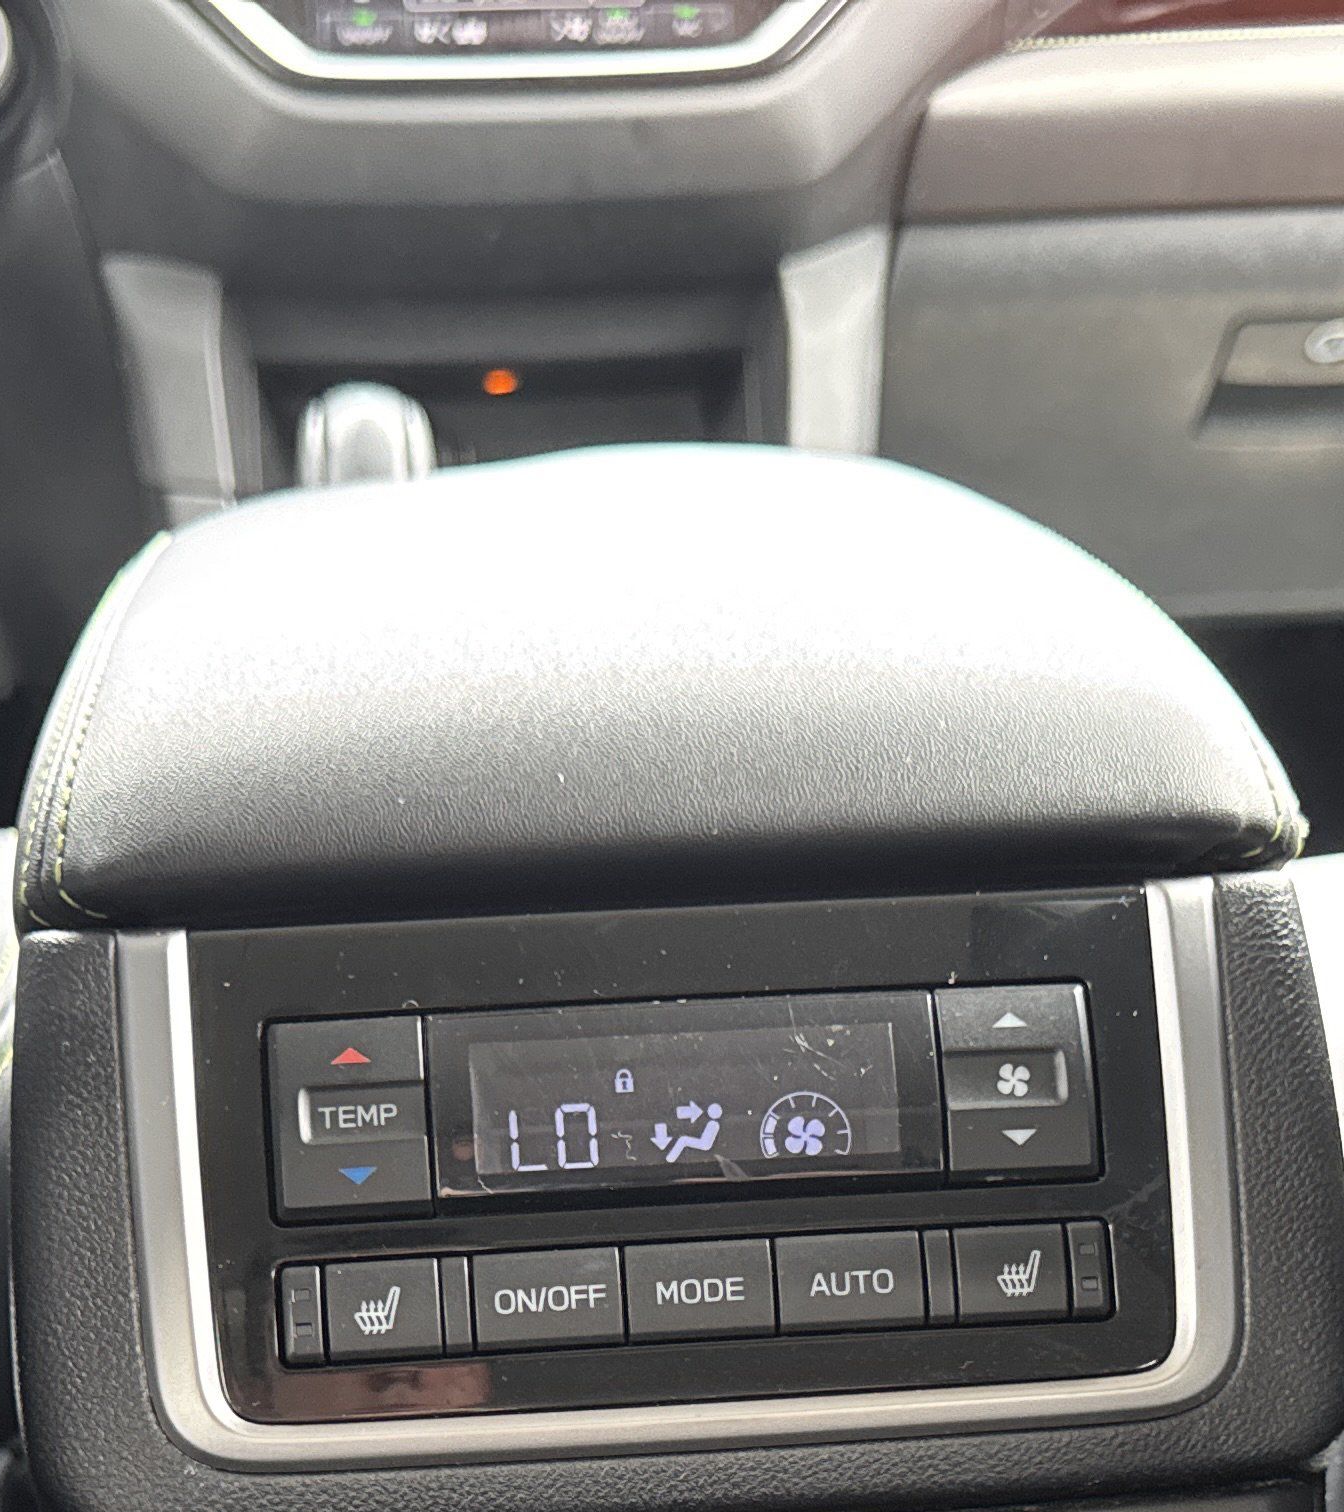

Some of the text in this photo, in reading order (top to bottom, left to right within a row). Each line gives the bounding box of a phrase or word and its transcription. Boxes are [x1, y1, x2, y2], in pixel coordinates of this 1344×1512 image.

[317, 1103, 398, 1129] TEMP
[656, 1276, 745, 1305] MODE
[809, 1268, 895, 1298] AUTO
[493, 1283, 608, 1315] ON/OFF
